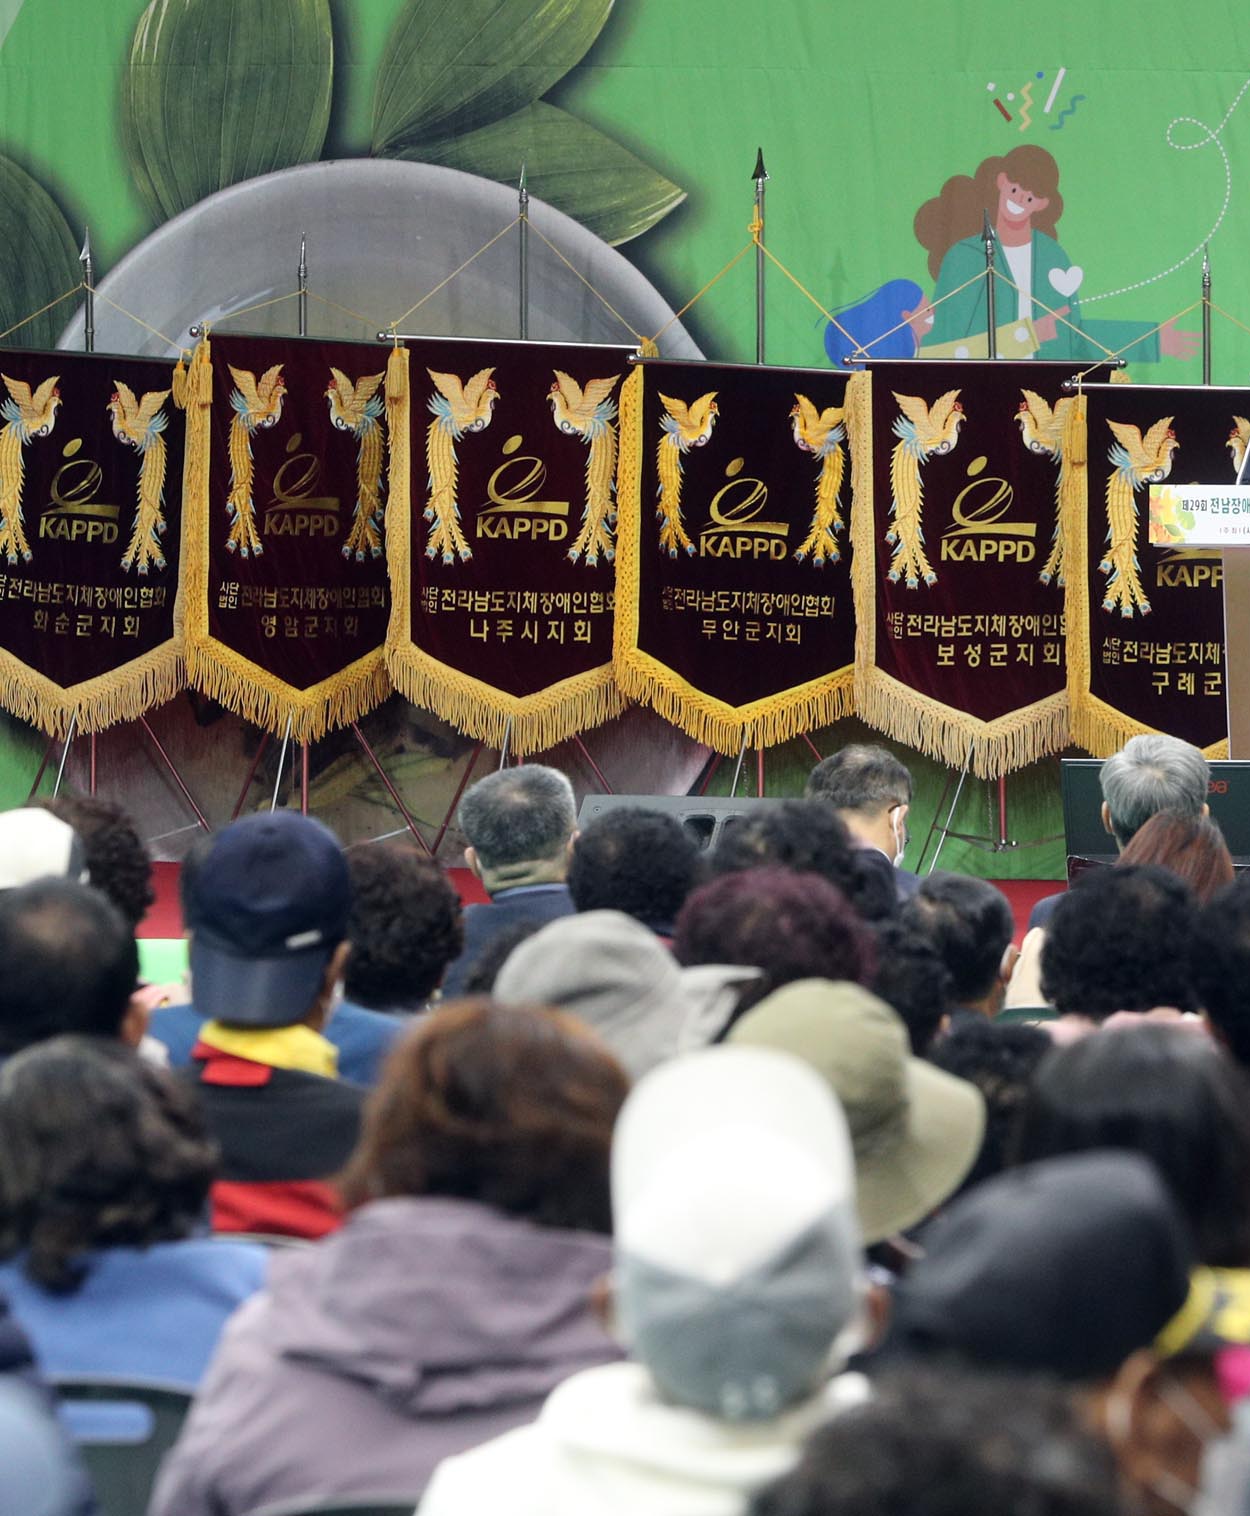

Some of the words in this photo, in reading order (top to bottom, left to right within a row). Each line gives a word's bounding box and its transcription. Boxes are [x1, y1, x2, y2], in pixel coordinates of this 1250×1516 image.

[1182, 499, 1208, 512] 제29회
[39, 516, 119, 544] KAPPD
[264, 513, 340, 537] KAPPD
[476, 516, 568, 541] KAPPD
[700, 535, 788, 561] KAPPD
[940, 539, 1036, 563] KAPPD
[8, 577, 167, 609] 전라남도지체장애인협회
[674, 587, 836, 618] 전라남도지체장애인협회
[33, 609, 140, 638] 화순군지회
[261, 615, 359, 639] 영암군지회
[469, 618, 592, 645] 나주시지회
[701, 619, 801, 645] 무안군지회
[936, 643, 1061, 668] 보성군지회
[1123, 641, 1225, 665] 전라남도지체
